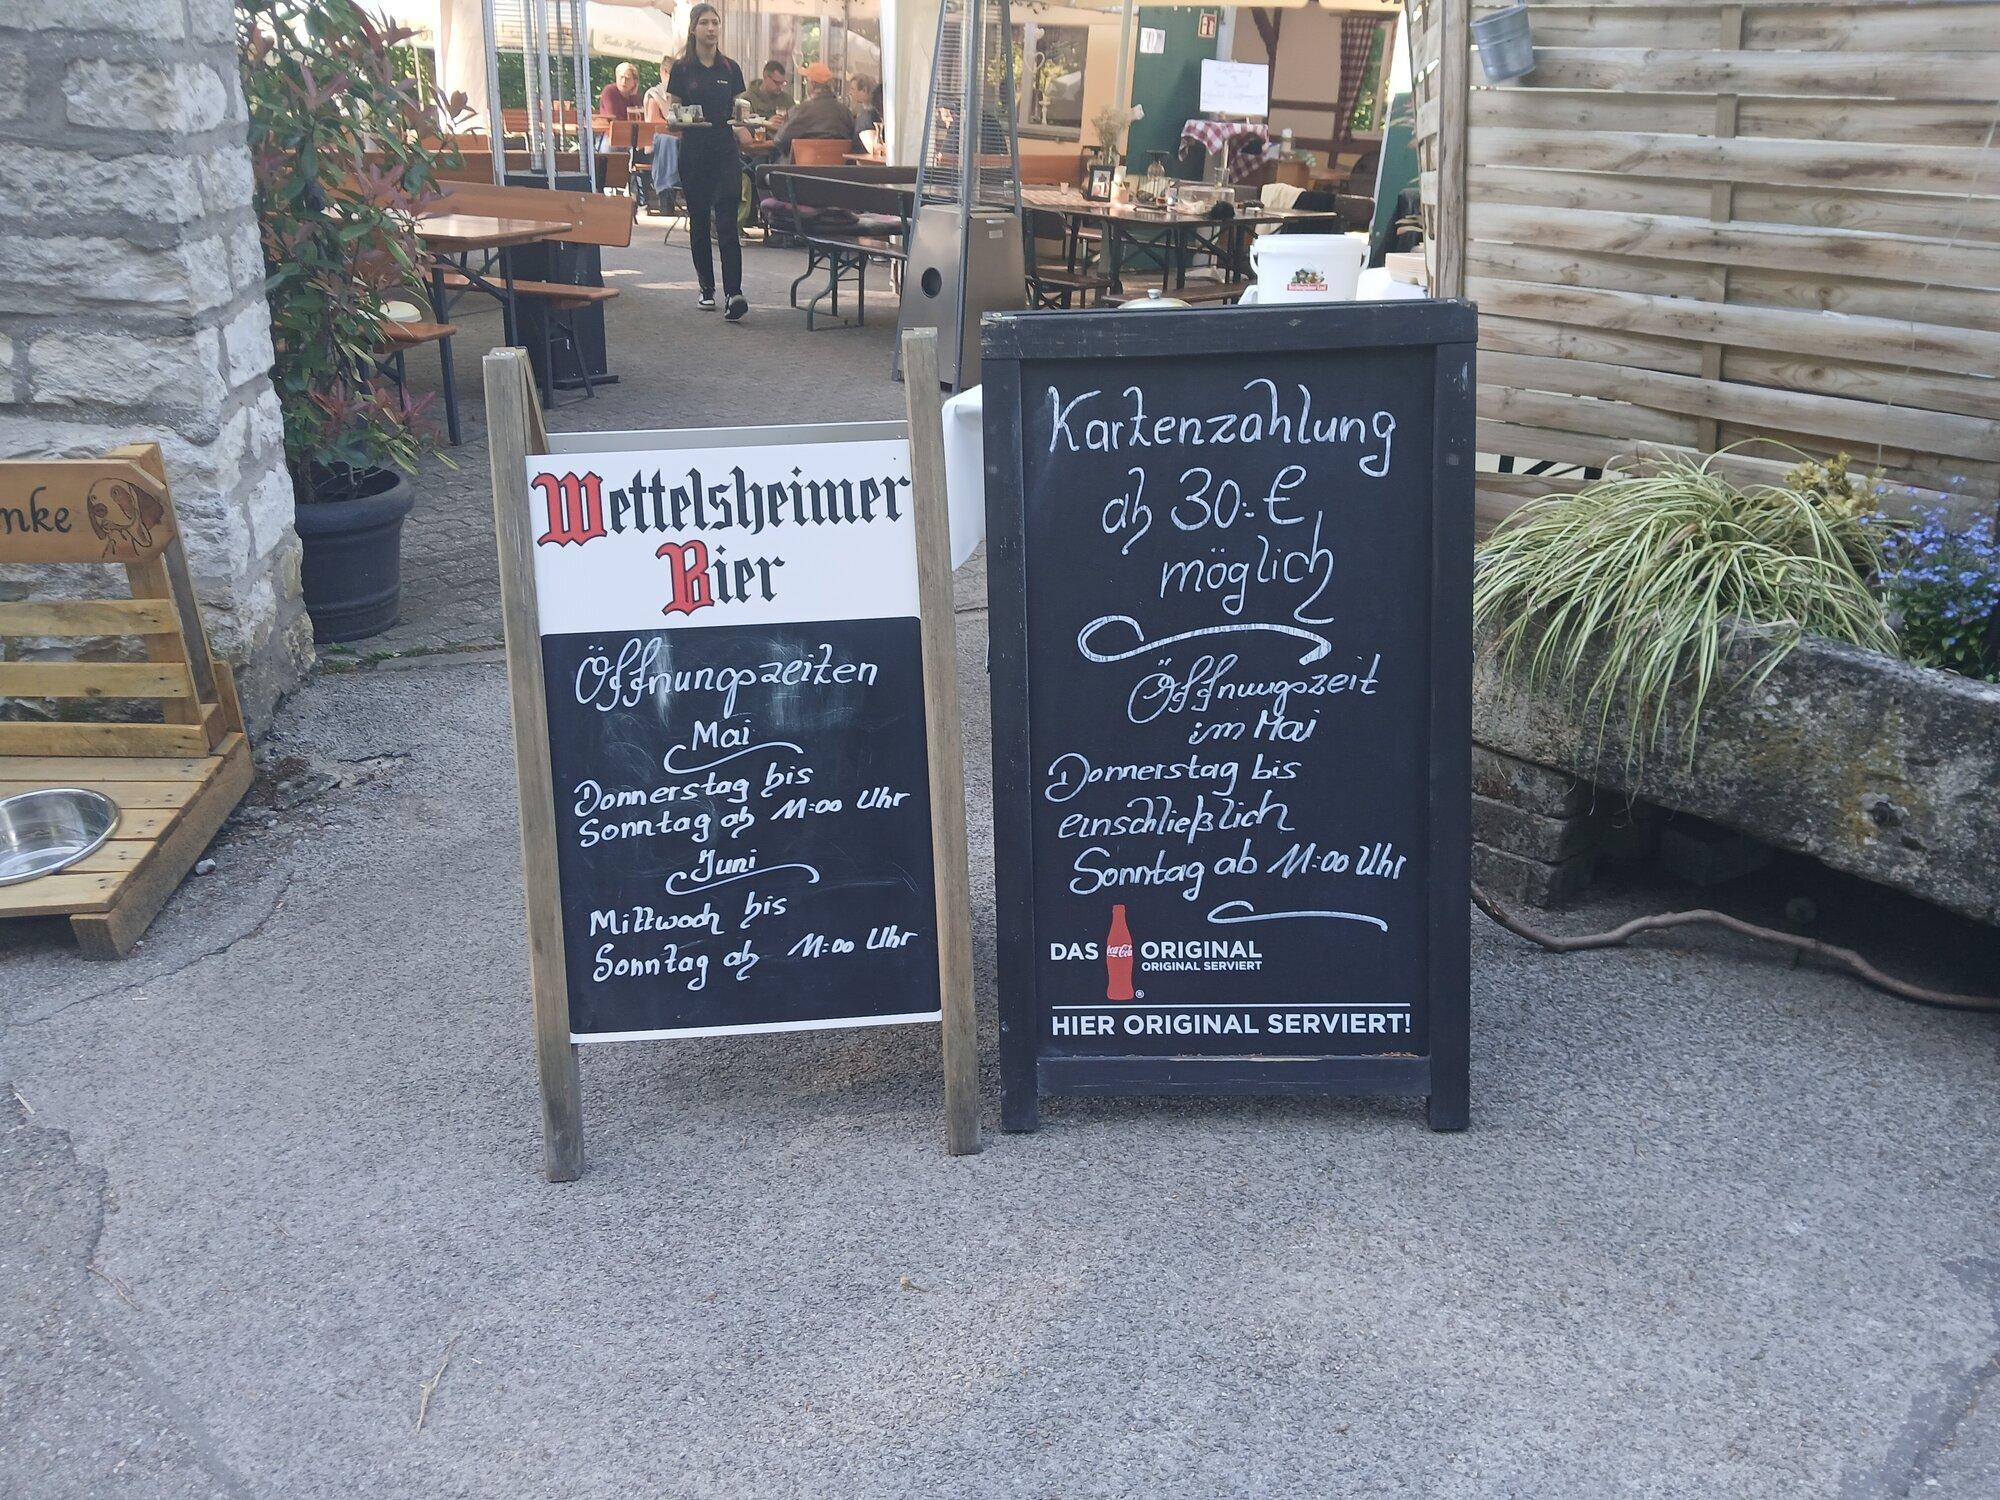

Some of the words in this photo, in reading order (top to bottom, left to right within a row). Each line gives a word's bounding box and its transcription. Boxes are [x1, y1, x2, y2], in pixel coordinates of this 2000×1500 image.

[1048, 378, 1396, 477] Kartenzahlung
[531, 466, 911, 548] Wettelsheimer
[1102, 466, 1152, 555] ab
[656, 539, 785, 616] Bier
[1160, 510, 1334, 624] möglich
[575, 636, 878, 719] Öffnungszeiten
[692, 720, 752, 751] Mai
[1188, 722, 1245, 744] im
[1252, 709, 1320, 742] Mai
[574, 773, 749, 817] Donnerstag
[764, 762, 814, 797] bis
[1045, 753, 1238, 802] Donnerstag
[1251, 753, 1302, 780] bis
[579, 811, 711, 848] Sonntag
[721, 806, 755, 839] ab
[857, 787, 911, 809] Uhr
[1057, 790, 1295, 844] einschließlich
[690, 849, 758, 882] Juni
[1070, 847, 1205, 901] Sonntag
[1213, 838, 1258, 876] ab
[1356, 843, 1407, 879] Uhr
[589, 903, 724, 937] Mittwoch
[739, 892, 788, 930] bis
[592, 943, 709, 991] Sonntag
[723, 940, 761, 981] ab
[866, 925, 919, 950] Uhr
[1050, 942, 1099, 961] DAS
[1140, 941, 1263, 959] ORIGINAL
[1141, 961, 1201, 972] ORIGINAL
[1203, 960, 1263, 971] SERVIERT
[1052, 1015, 1115, 1036] HIER
[1123, 1014, 1260, 1035] ORIGINAL
[1267, 1013, 1411, 1034] SERVIERT!
